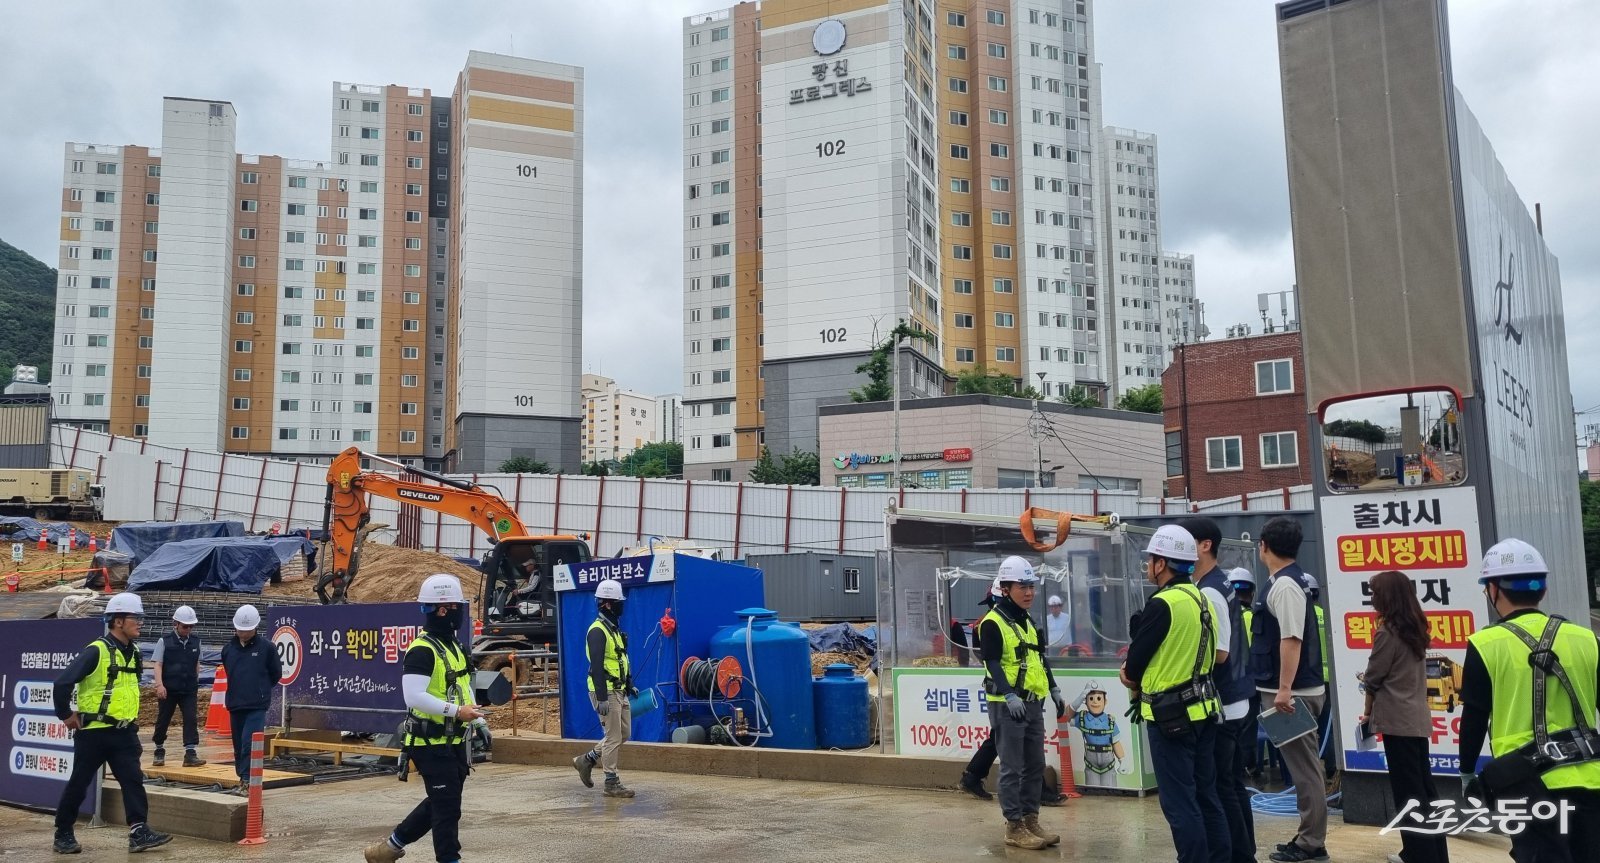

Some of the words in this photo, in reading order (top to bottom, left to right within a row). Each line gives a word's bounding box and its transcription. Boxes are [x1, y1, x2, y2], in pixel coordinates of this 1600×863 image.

[789, 77, 872, 105] 프로그레스
[815, 139, 846, 158] 102
[516, 164, 537, 178] 101
[819, 327, 847, 343] 102
[514, 394, 533, 407] 101
[1494, 361, 1532, 428] LEEPS
[400, 489, 440, 501] DEVELON
[1353, 499, 1442, 529] 출차시
[1340, 535, 1463, 567] 일시정지!!
[578, 562, 645, 584] 슬러지보관소
[1347, 615, 1471, 645] 확저!!
[276, 641, 296, 667] 20
[346, 629, 379, 660] 확인!
[21, 652, 51, 670] 현장출입
[310, 672, 329, 694] 오늘도
[924, 688, 971, 713] 설마를
[911, 724, 952, 747] 100%
